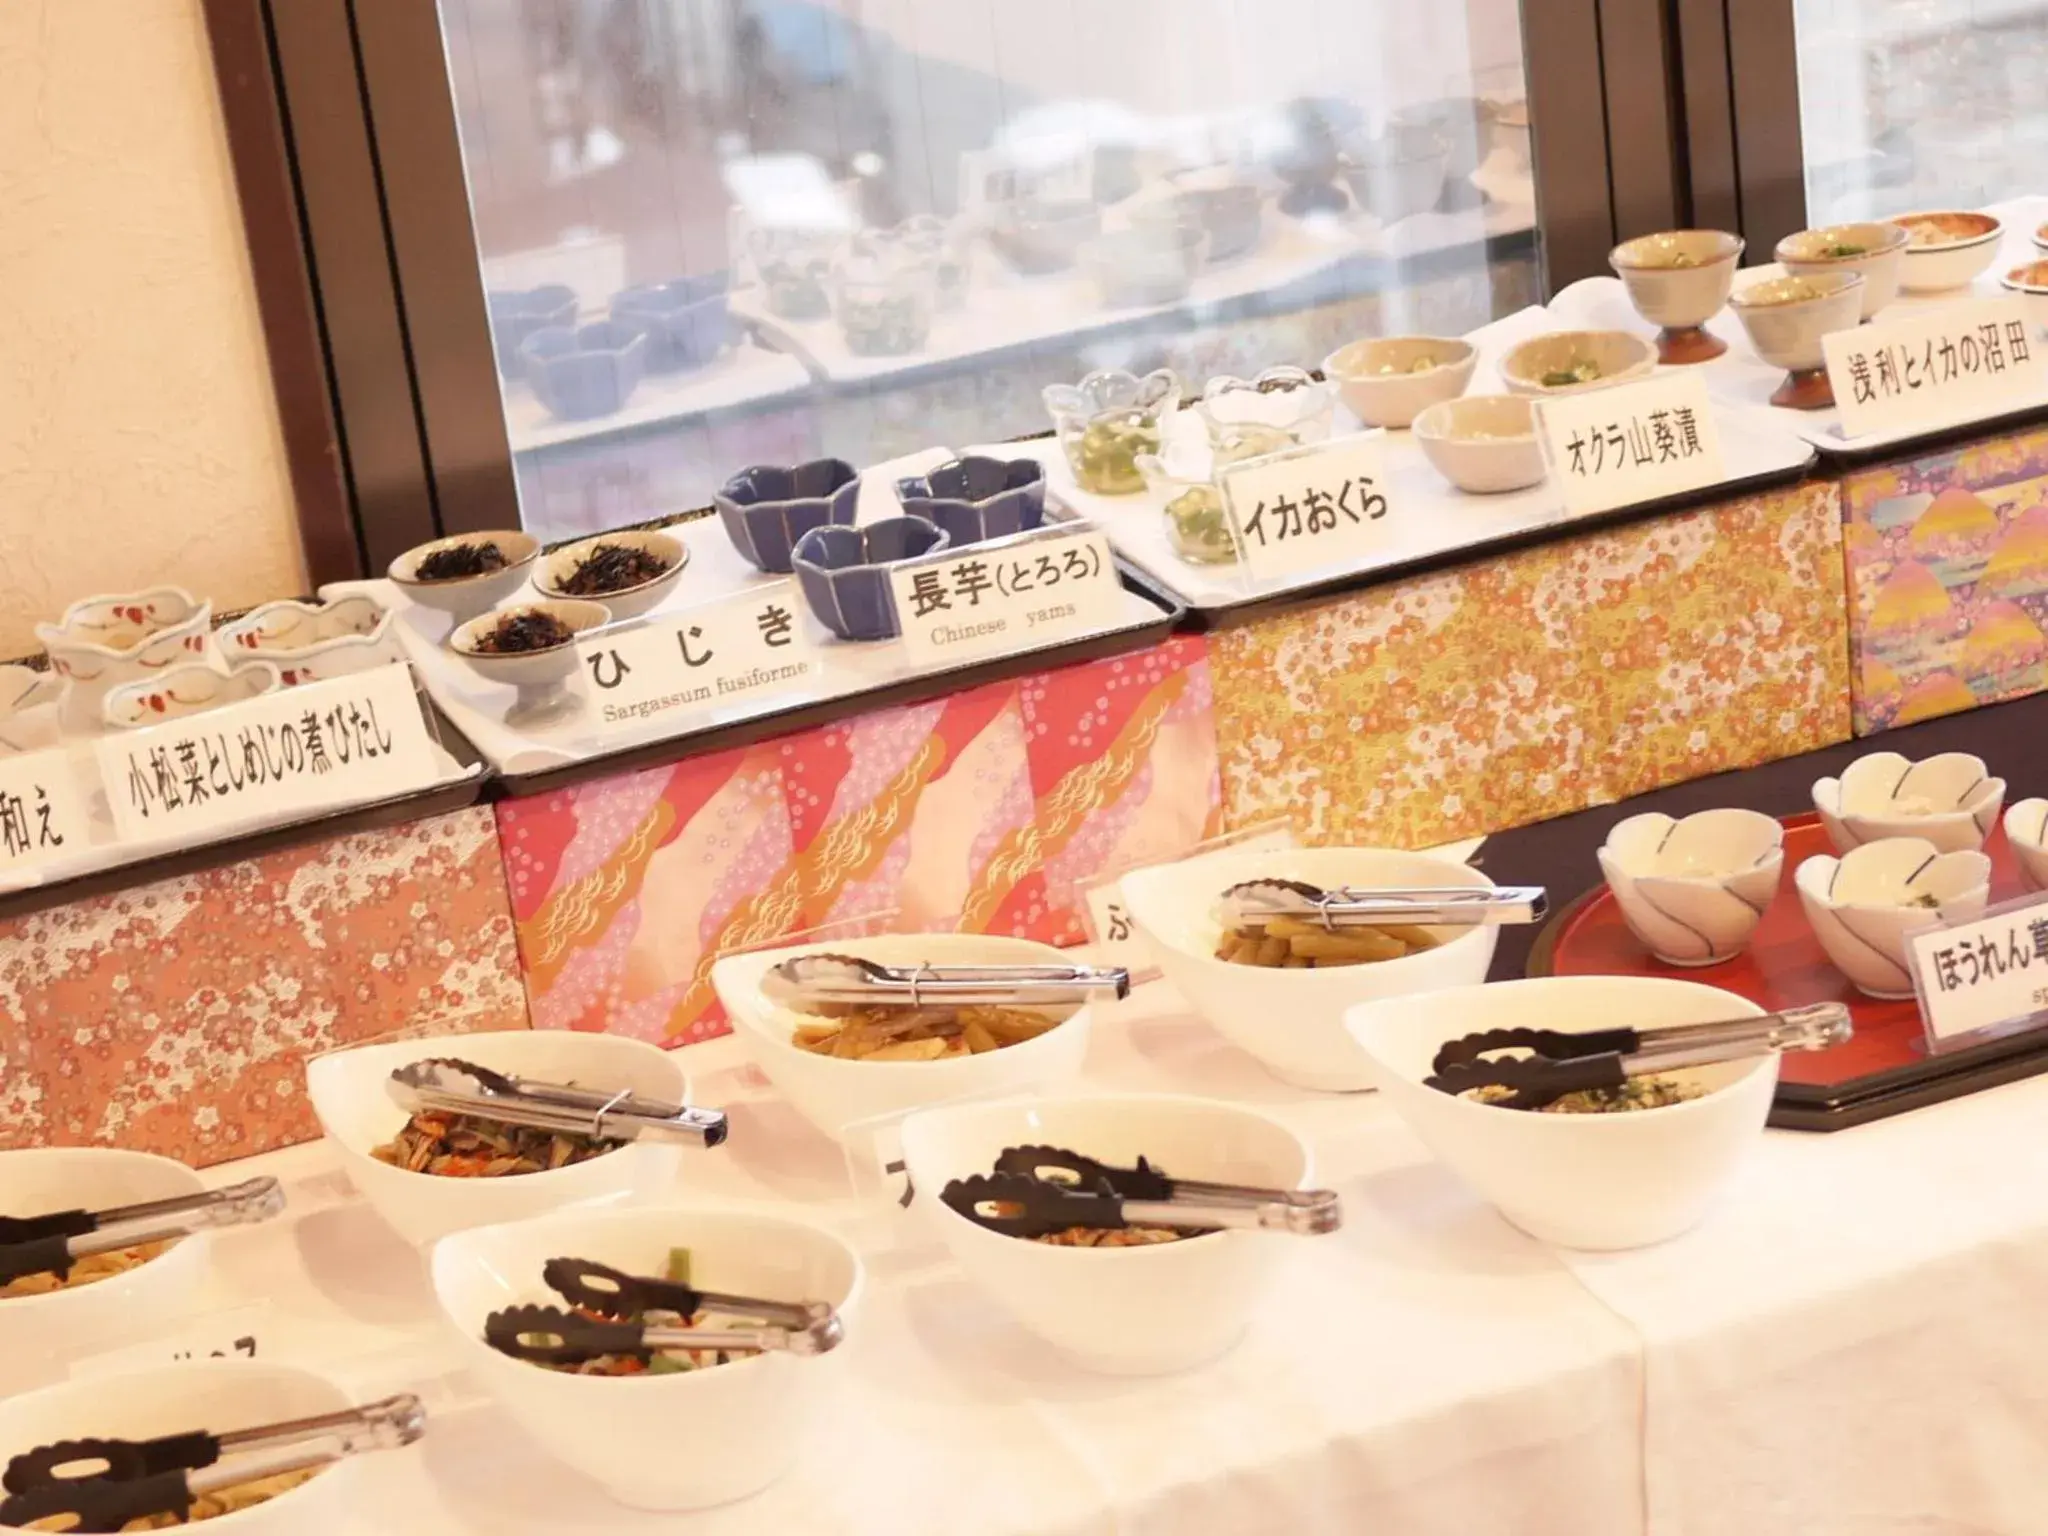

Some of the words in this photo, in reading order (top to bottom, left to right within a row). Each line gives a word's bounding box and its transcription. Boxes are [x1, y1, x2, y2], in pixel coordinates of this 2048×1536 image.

[1849, 320, 2030, 404] 浅利とイカの沼田
[1566, 406, 1703, 477] オクラ山葵漬
[1243, 476, 1388, 546] イカおくら
[930, 617, 1007, 646] Chinese
[1026, 602, 1077, 627] yams
[603, 684, 712, 723] Sargassum
[716, 661, 809, 697] fusiforme
[128, 697, 393, 818] 小松菜としめじの煮ひたし
